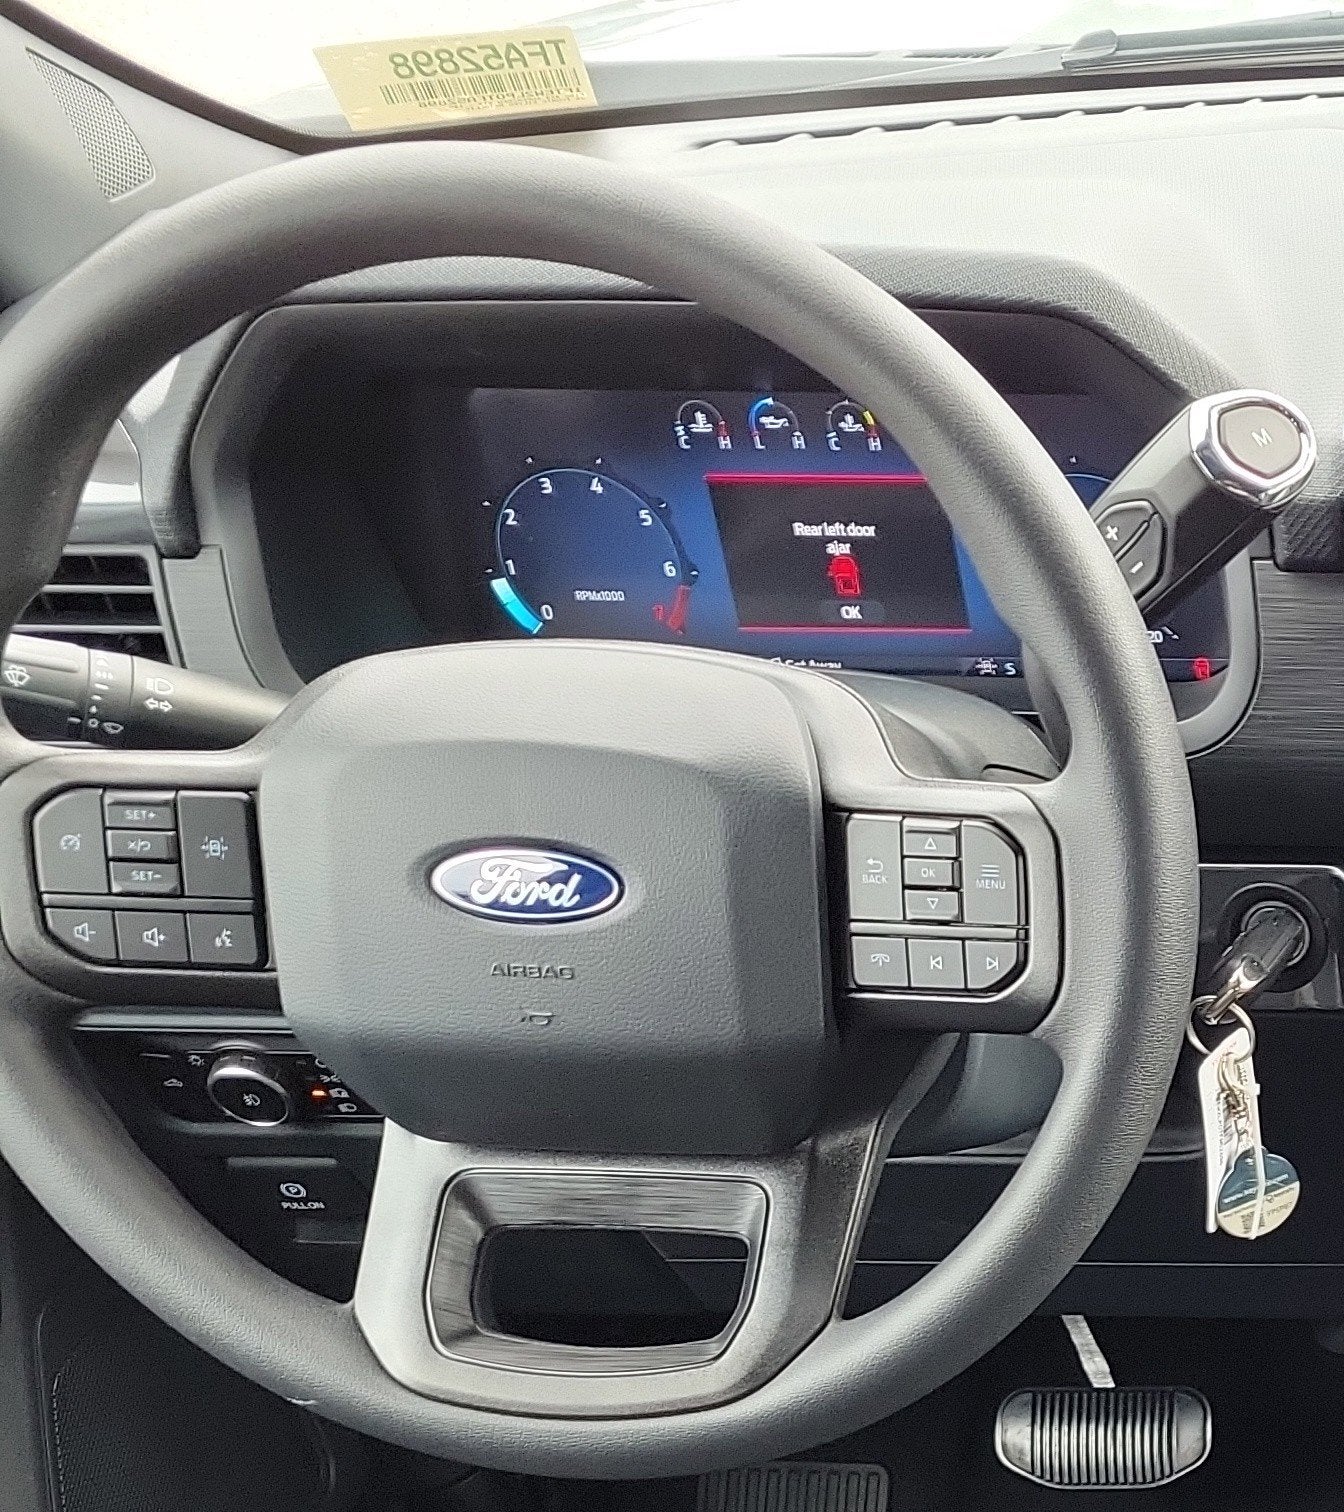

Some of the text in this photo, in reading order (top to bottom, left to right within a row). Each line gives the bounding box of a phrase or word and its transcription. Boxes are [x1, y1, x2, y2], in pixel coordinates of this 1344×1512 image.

[1252, 428, 1273, 448] M
[541, 478, 553, 494] 3
[589, 478, 604, 493] 4
[504, 509, 518, 525] 2
[639, 510, 653, 526] 5
[793, 521, 876, 536] Rear left door
[826, 542, 851, 556] ajar
[506, 560, 516, 576] 1
[662, 561, 677, 578] 6
[541, 604, 554, 620] 0
[840, 605, 863, 620] OK
[862, 873, 888, 885] BACK
[921, 868, 936, 878] OK
[470, 857, 582, 907] Ford
[975, 879, 1006, 890] MENU
[490, 963, 575, 980] AIRBAG
